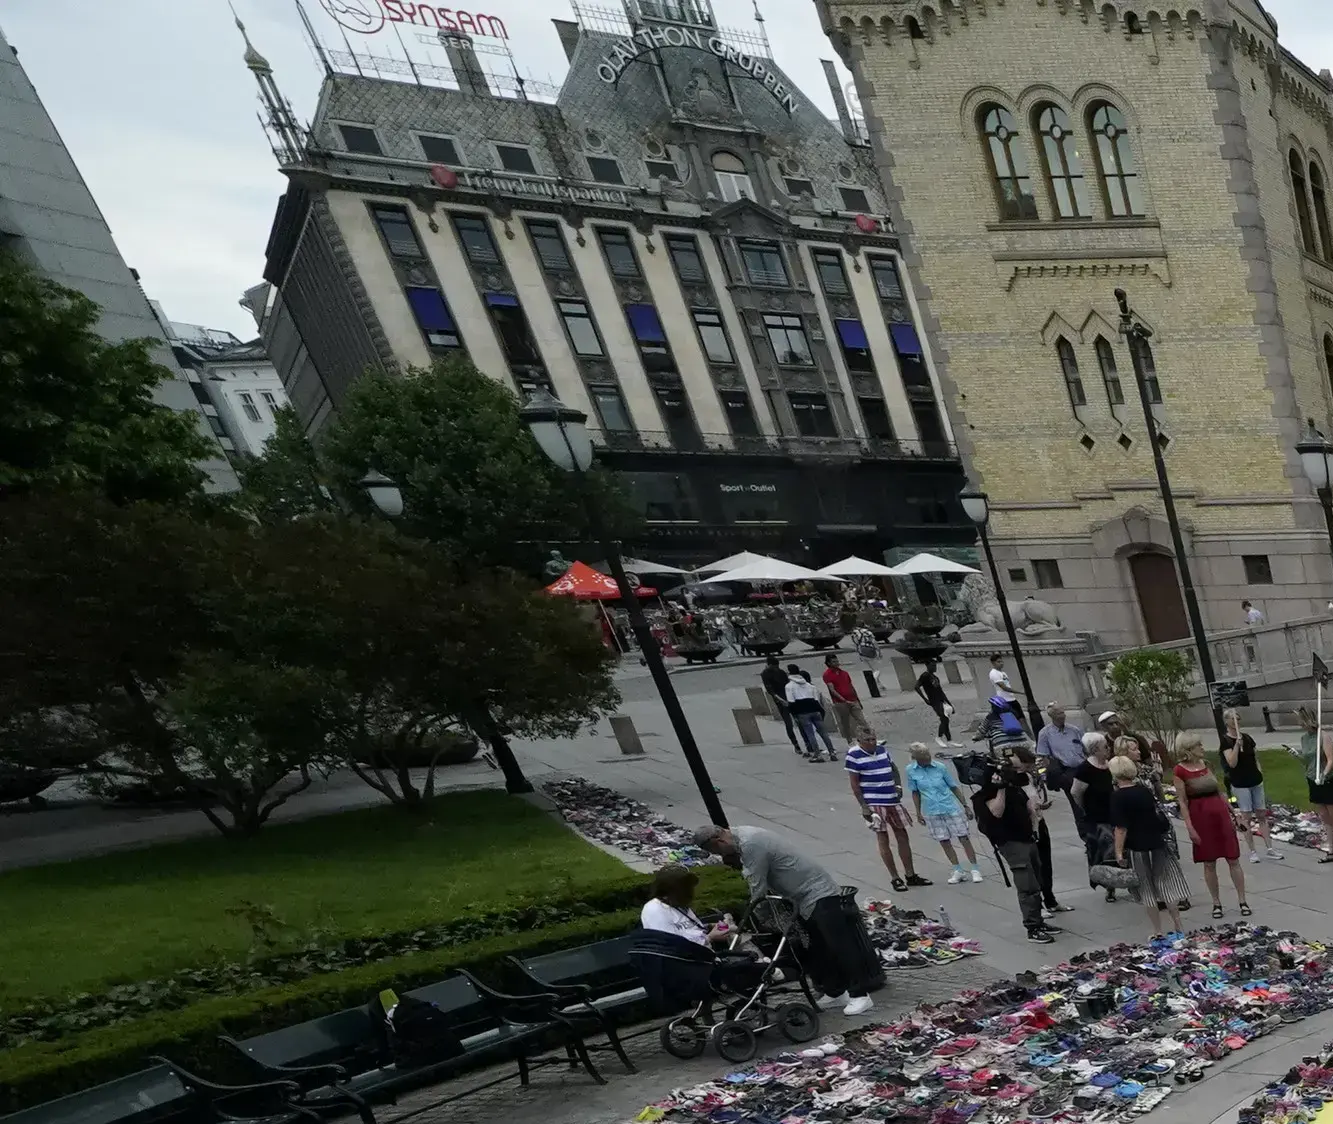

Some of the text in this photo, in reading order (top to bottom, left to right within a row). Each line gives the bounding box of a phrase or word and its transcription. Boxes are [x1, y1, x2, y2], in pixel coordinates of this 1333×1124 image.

[382, 0, 510, 41] SYNSAM
[597, 26, 800, 113] OLAV THON GRUPPEN
